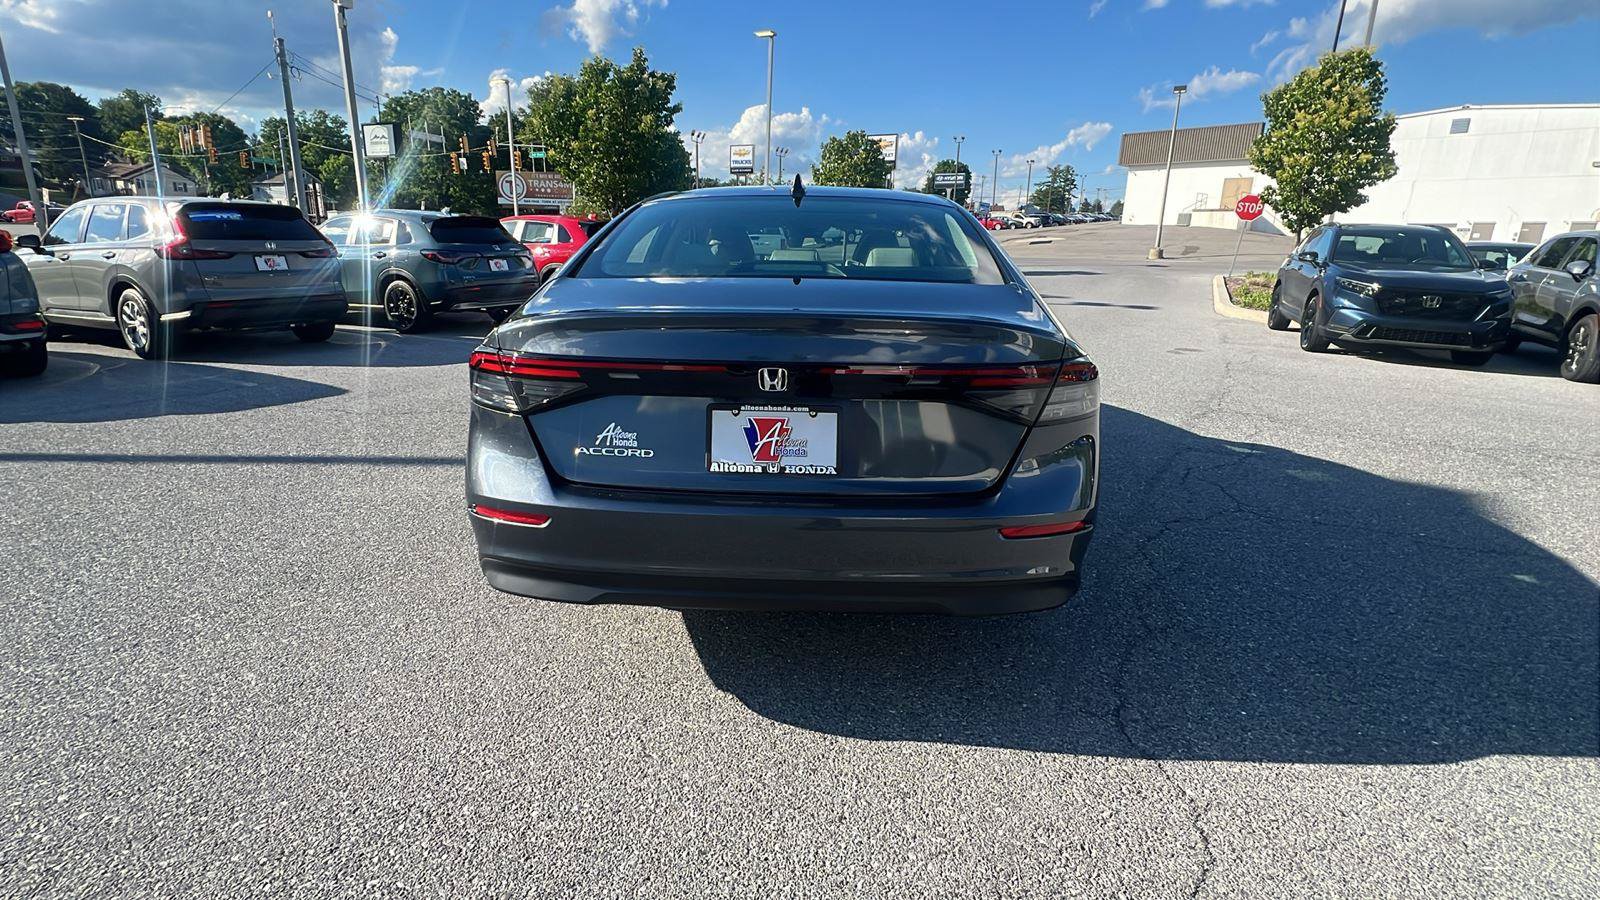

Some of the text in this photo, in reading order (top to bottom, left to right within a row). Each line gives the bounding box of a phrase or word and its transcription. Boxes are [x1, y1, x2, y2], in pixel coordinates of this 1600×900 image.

[1237, 201, 1263, 214] STOP
[595, 422, 637, 446] Altoona
[754, 422, 808, 456] Altoona
[613, 438, 638, 447] Honda
[574, 446, 654, 458] ACCORD
[775, 446, 807, 457] Honda
[710, 462, 763, 474] Altoona
[785, 465, 838, 475] HONDA
